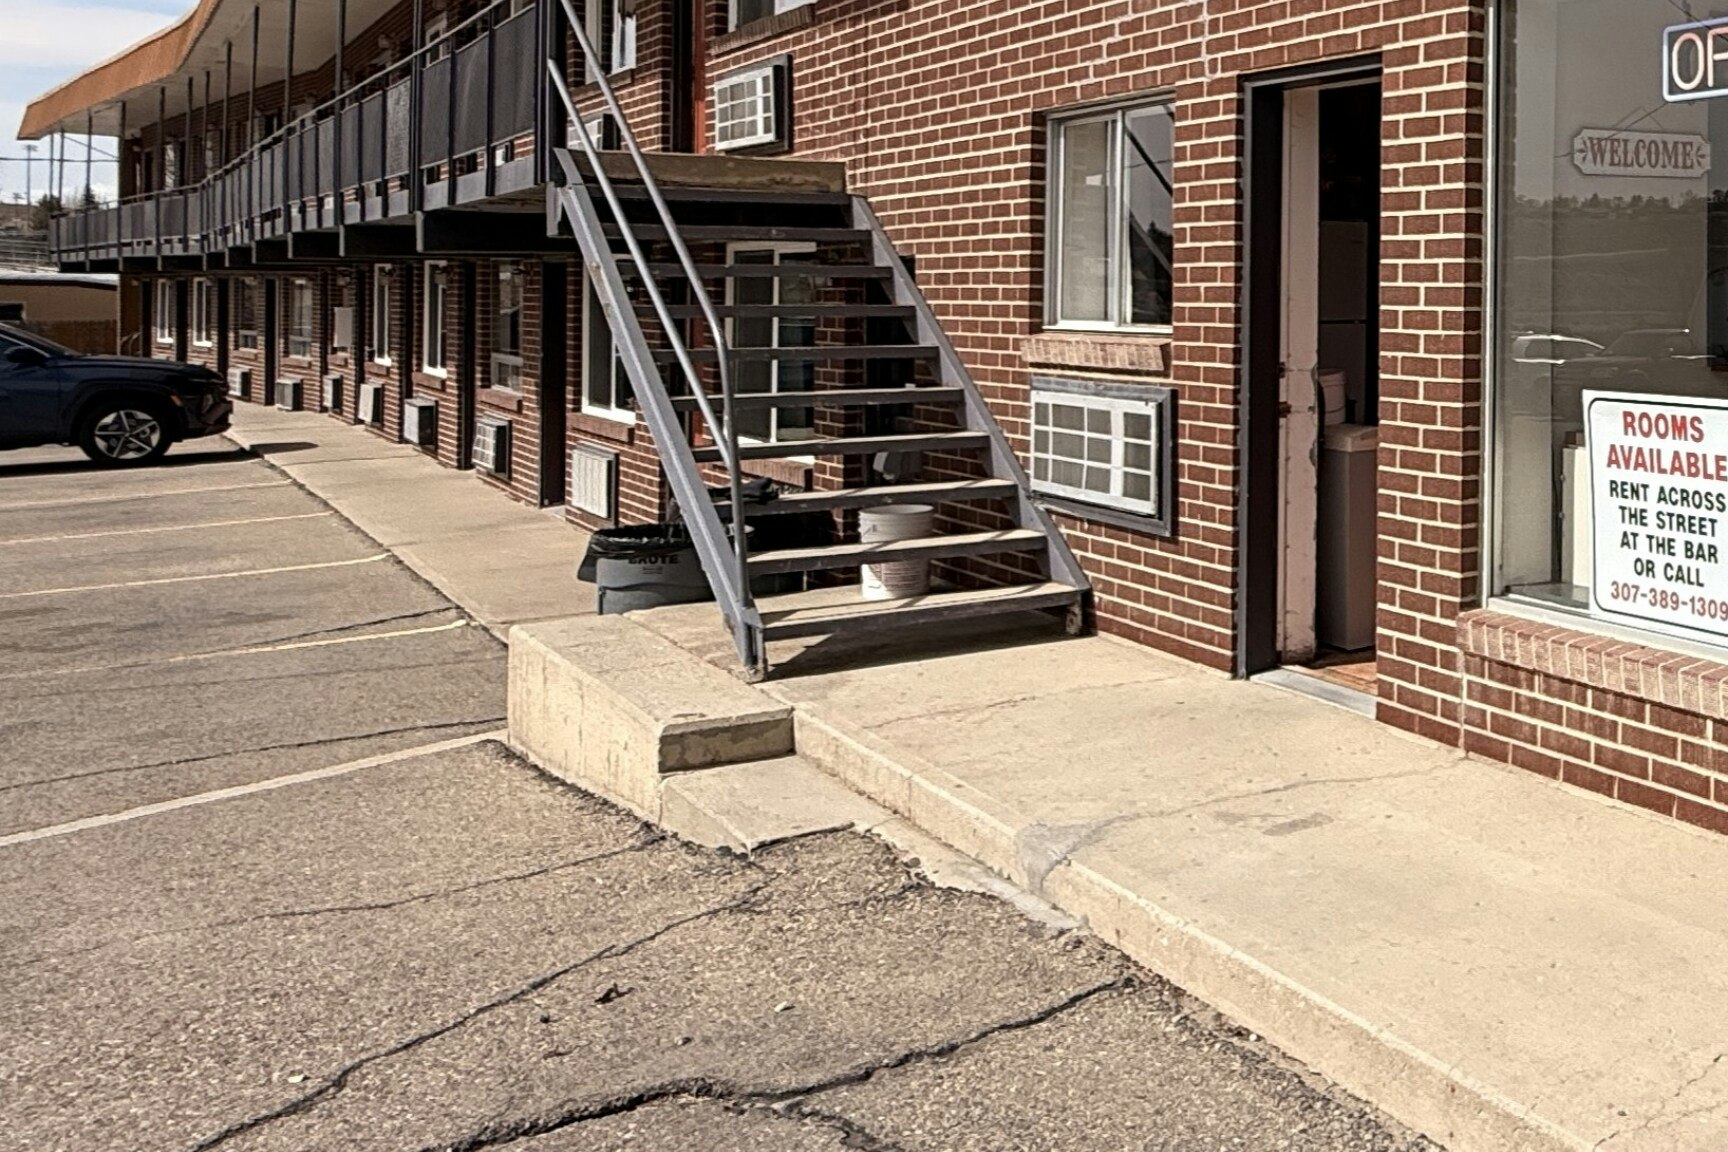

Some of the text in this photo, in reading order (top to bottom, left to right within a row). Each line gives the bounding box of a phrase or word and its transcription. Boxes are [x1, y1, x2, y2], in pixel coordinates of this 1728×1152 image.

[1587, 137, 1694, 170] WELCOME
[1622, 411, 1705, 443] ROOMS
[1606, 444, 1728, 482] AVAILABLE
[1609, 480, 1727, 513] RENT ACROSS
[1618, 505, 1718, 538] THE STREET
[1620, 531, 1719, 564] AT THE BAR
[1633, 557, 1705, 588] OR CALL
